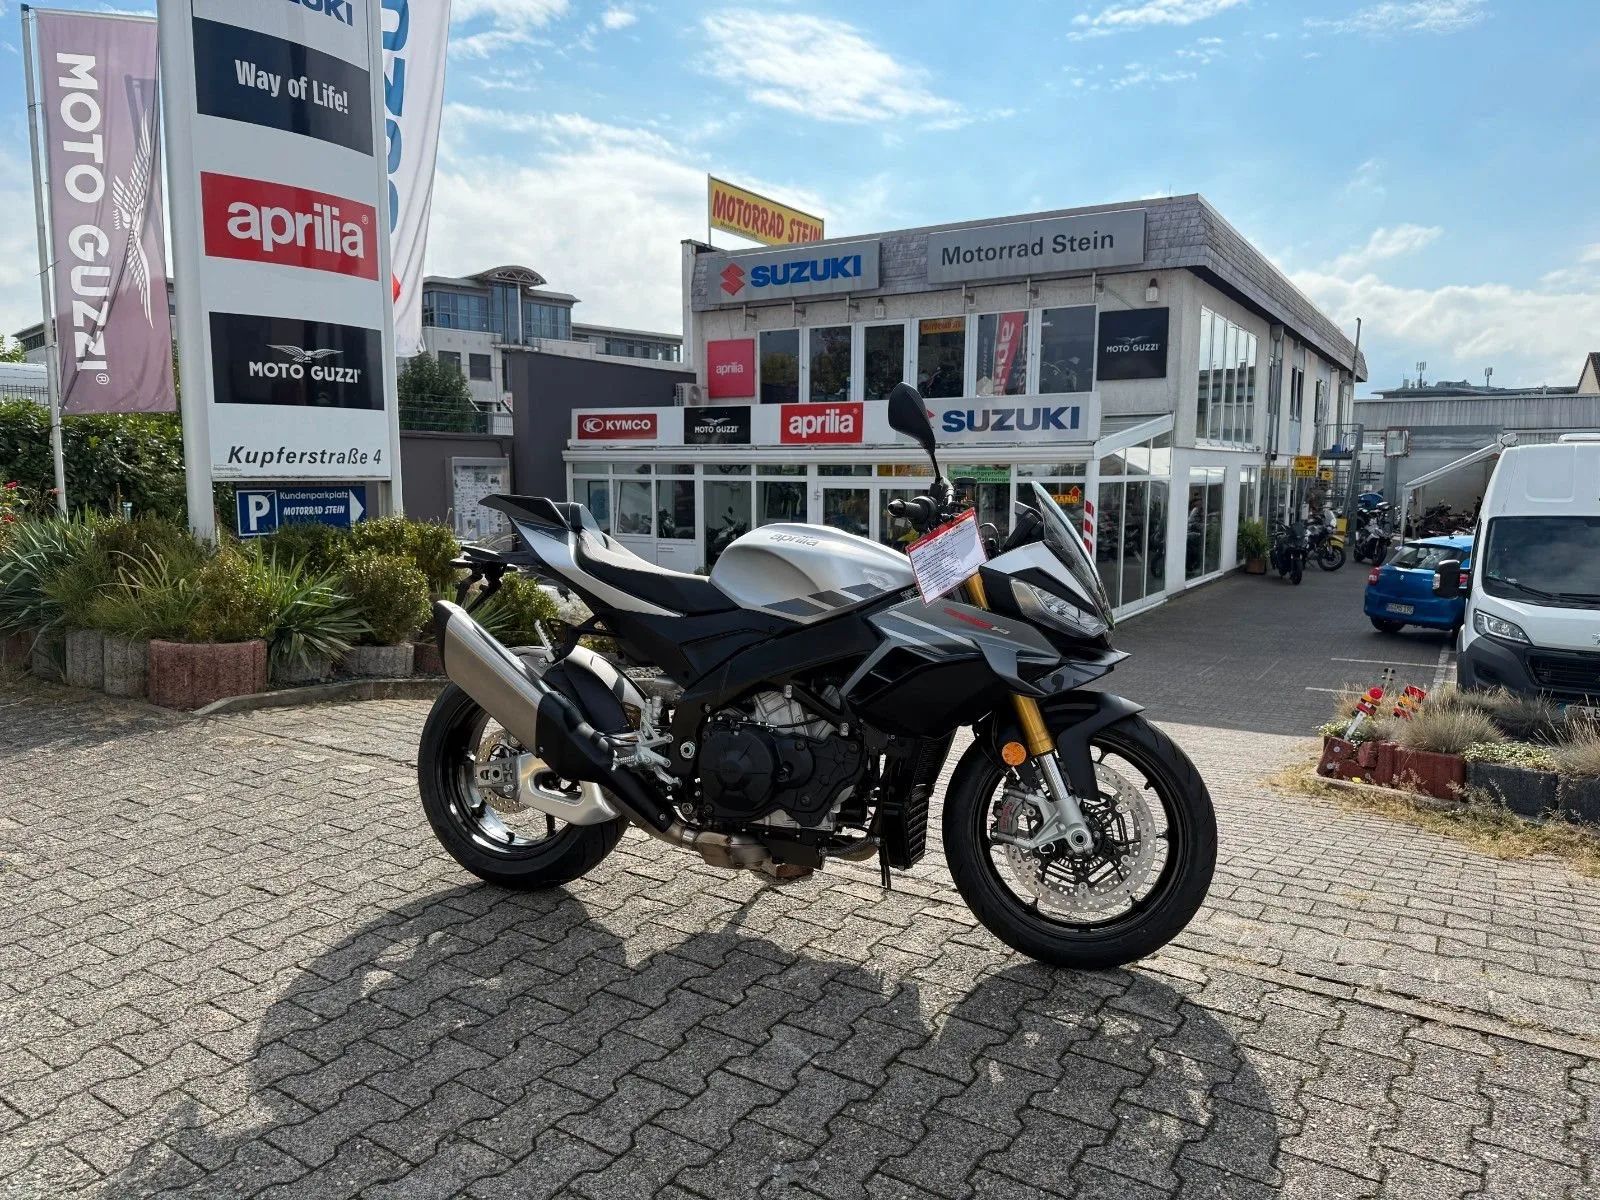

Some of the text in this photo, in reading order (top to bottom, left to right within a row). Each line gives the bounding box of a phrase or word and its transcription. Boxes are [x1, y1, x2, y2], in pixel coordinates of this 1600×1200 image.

[289, 0, 353, 26] UKI
[234, 59, 349, 115] Way of Life!
[56, 52, 110, 371] MOTO GUZZI
[712, 189, 821, 243] MOTORRAD STEIN
[227, 201, 365, 259] aprilia
[941, 230, 1114, 266] Motorrad Stein
[750, 254, 862, 288] SUZUKI
[1106, 342, 1159, 353] MOTO GUZZI
[249, 361, 358, 384] MOTO GUZZI
[715, 363, 744, 376] aprilia
[606, 420, 651, 430] KYMCO
[694, 424, 737, 434] MOTO GUZZI
[788, 408, 854, 438] aprilia
[941, 405, 1080, 433] SUZUKI
[227, 445, 368, 468] Kupferstraße
[373, 449, 382, 465] 4
[280, 491, 349, 501] Kundenparkplatz
[248, 494, 271, 531] P
[283, 505, 345, 516] MOTORRAD STEIN
[770, 532, 819, 547] aprilia
